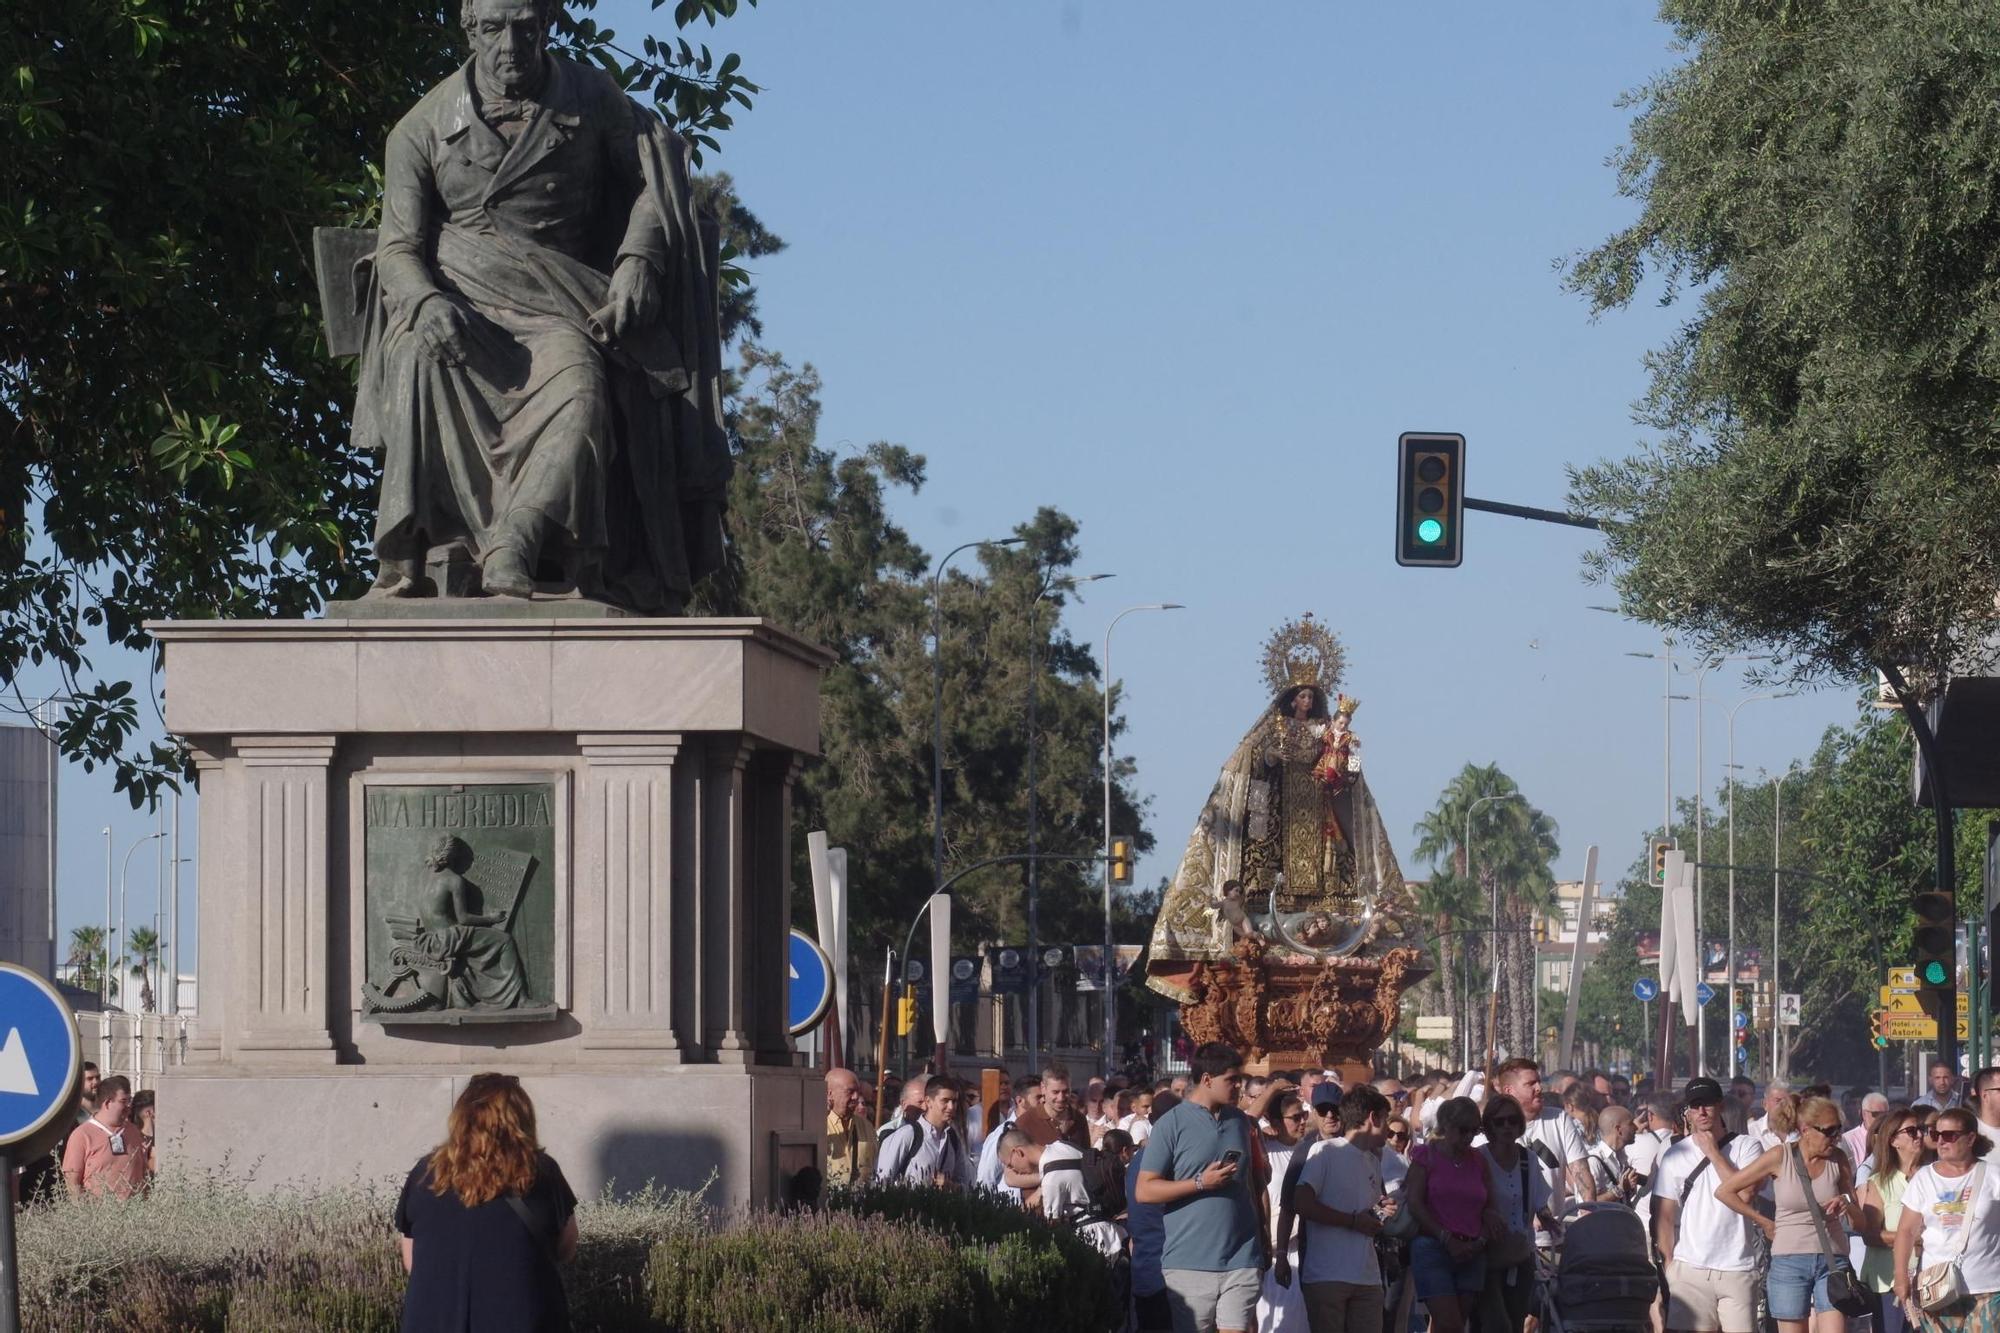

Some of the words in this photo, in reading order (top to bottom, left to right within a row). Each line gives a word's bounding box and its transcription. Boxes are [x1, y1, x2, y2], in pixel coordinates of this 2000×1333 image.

[420, 792, 553, 828] HEREDIA
[1891, 1020, 1910, 1028] Hotel
[1891, 1028, 1923, 1036] Astoria
